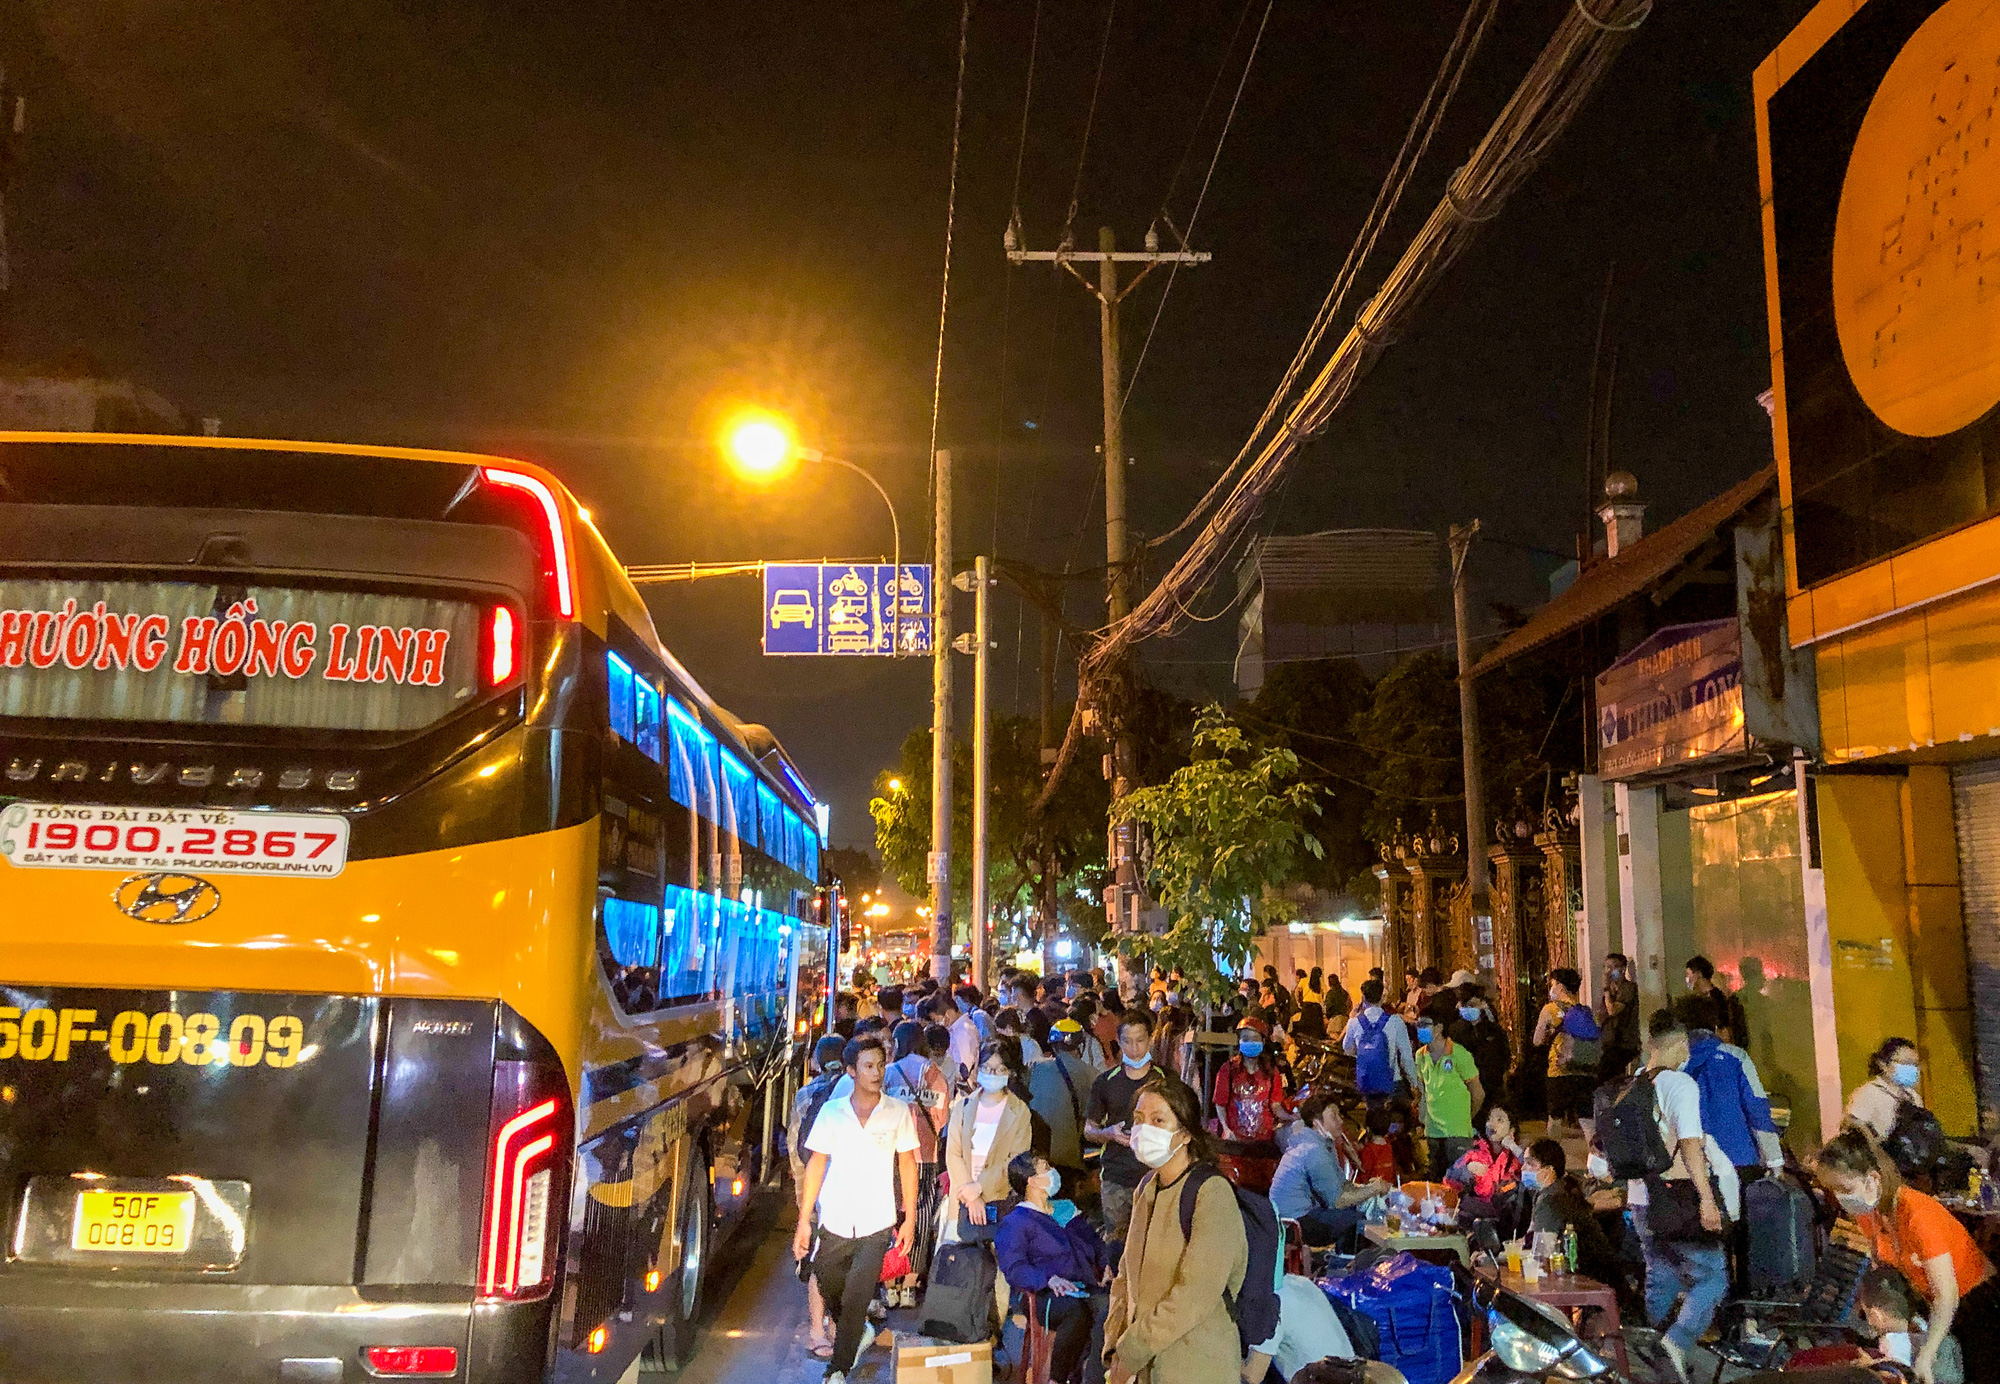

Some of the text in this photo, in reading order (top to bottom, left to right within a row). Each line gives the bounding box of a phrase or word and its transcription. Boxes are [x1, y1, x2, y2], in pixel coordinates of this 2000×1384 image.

[323, 623, 450, 687] LINH
[27, 822, 338, 859] 1900.2867
[83, 855, 138, 866] ONLINE
[112, 1196, 160, 1219] 50F
[88, 1222, 175, 1247] 008.09
